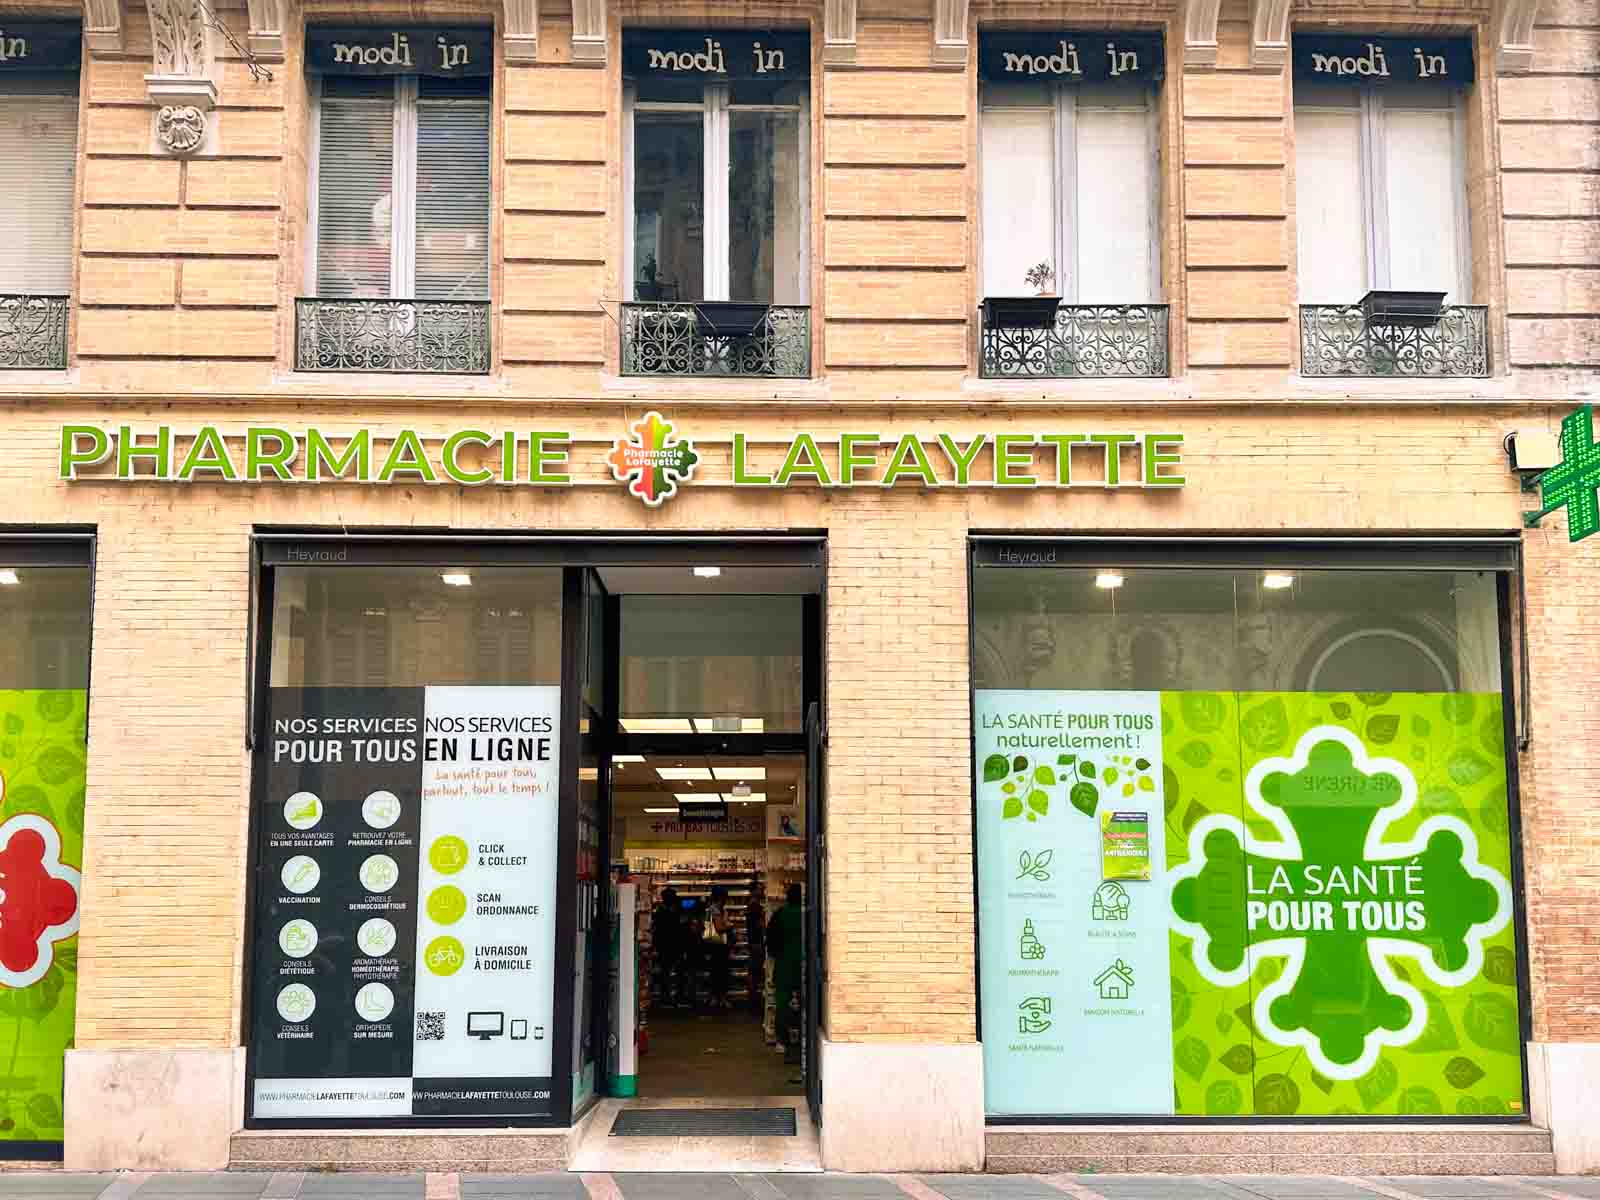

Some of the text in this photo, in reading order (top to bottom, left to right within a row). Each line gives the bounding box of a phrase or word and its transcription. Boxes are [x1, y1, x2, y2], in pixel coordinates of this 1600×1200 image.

[332, 32, 471, 69] modi in
[648, 38, 785, 72] modi in
[1003, 40, 1139, 75] modi in
[1312, 43, 1448, 77] modi in
[59, 424, 572, 486] PHARMACIE
[624, 448, 683, 458] Pharmacie
[733, 431, 1185, 488] LAFAYETTE
[626, 458, 681, 467] Lafayette
[287, 546, 347, 562] Heyraud
[1000, 548, 1056, 565] Heyraud
[274, 718, 417, 734] NOS SERVICES
[425, 716, 553, 733] NOS SERVICES
[982, 709, 1153, 730] LA SANTÉ POUR TOUS
[996, 732, 1141, 749] naturellement !
[274, 739, 417, 763] POUR TOUS
[424, 737, 551, 762] EN LIGNE
[435, 768, 449, 780] La
[453, 767, 481, 779] santé
[484, 770, 508, 784] pour
[473, 783, 496, 794] tout
[498, 783, 508, 793] le
[511, 783, 542, 797] temps
[314, 839, 334, 847] CARTE
[478, 844, 505, 854] CLICK
[478, 856, 528, 866] & COLLECT
[1247, 857, 1425, 895] LA SANTÉ
[476, 893, 501, 903] SCAN
[476, 905, 539, 915] ORDONNANCE
[1247, 900, 1426, 931] POUR TOUS
[475, 945, 528, 956] LIVRAISON
[474, 958, 532, 970] À DOMICILE
